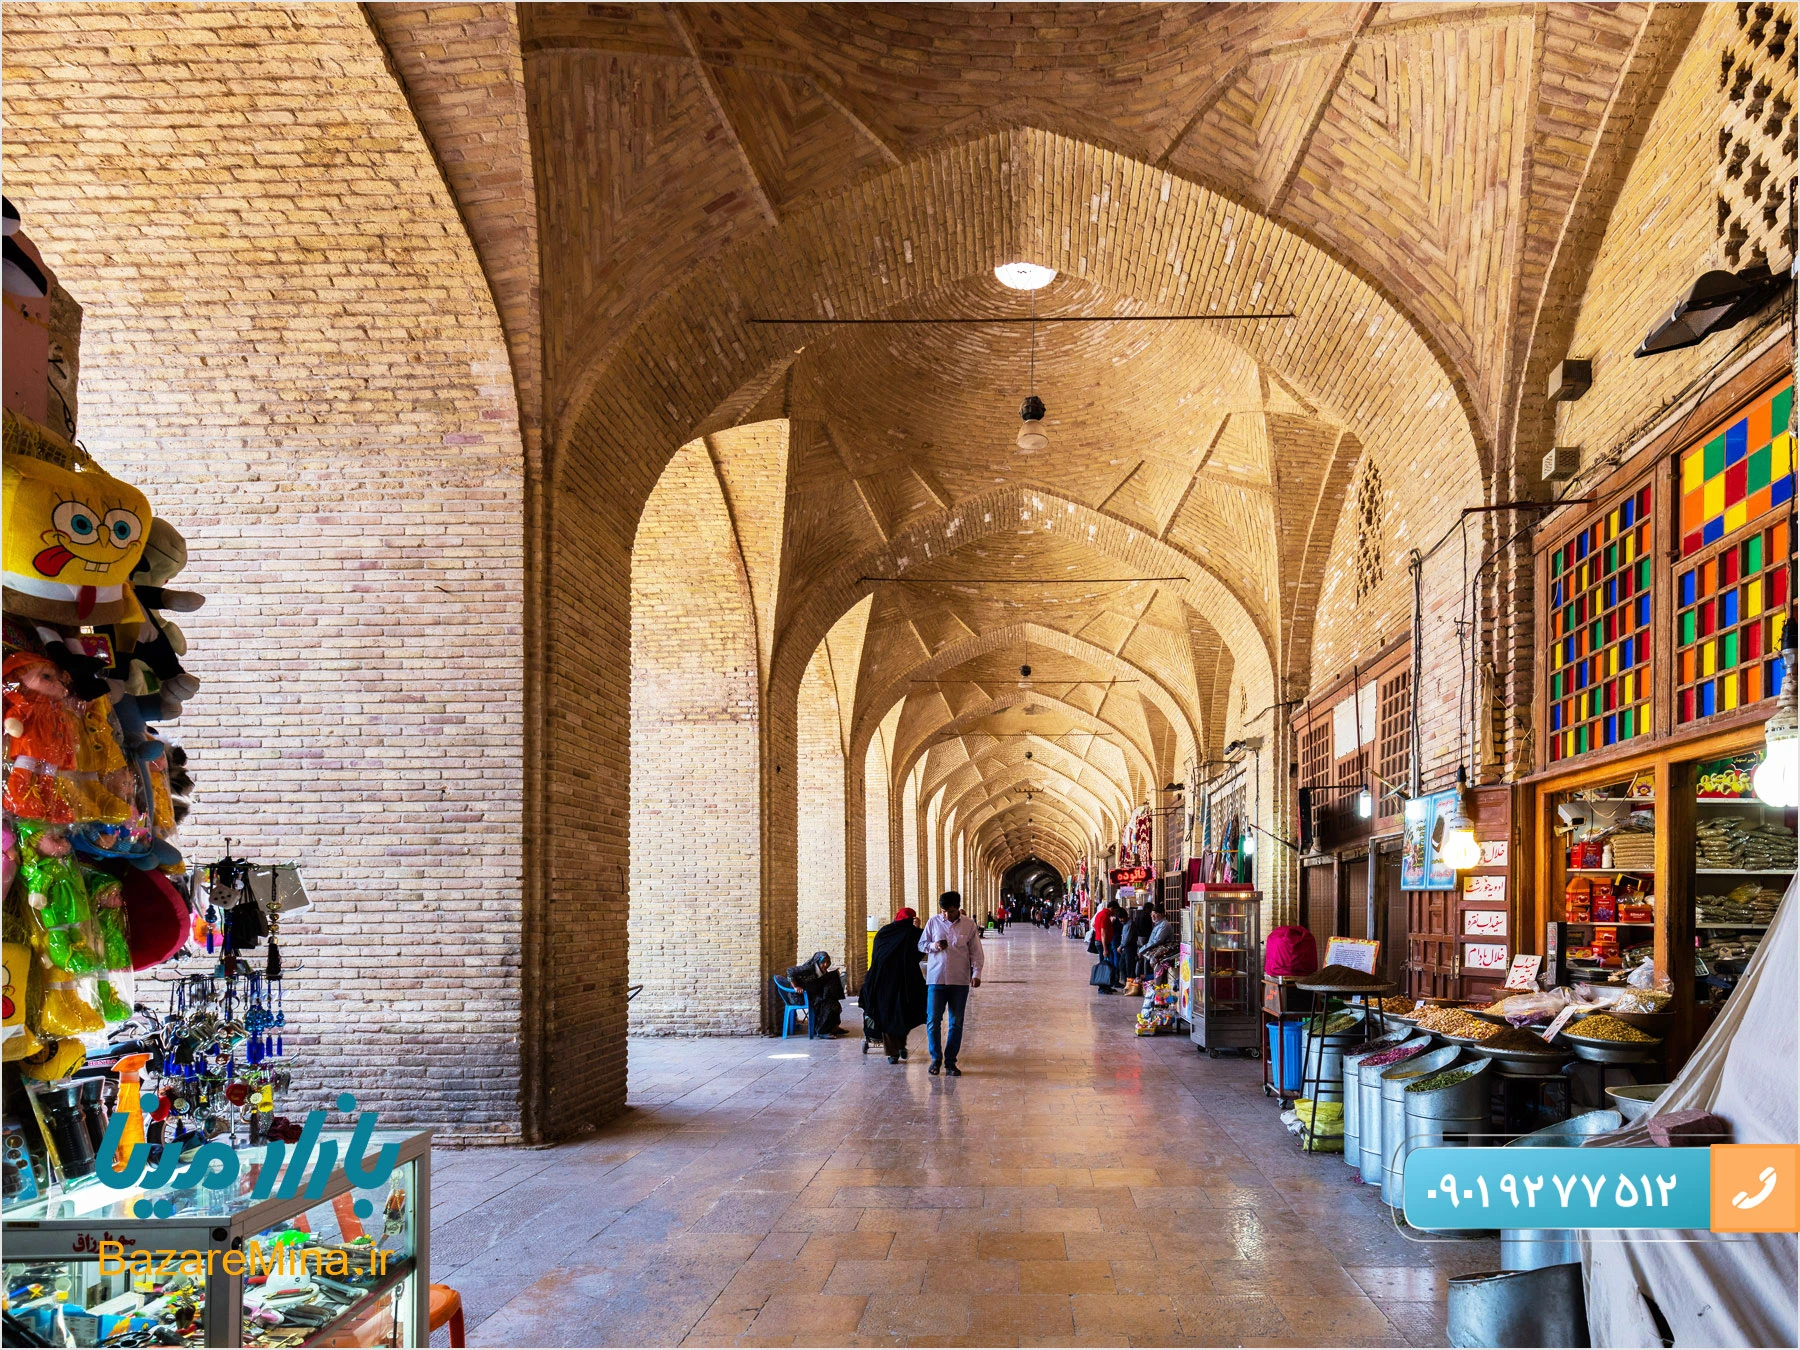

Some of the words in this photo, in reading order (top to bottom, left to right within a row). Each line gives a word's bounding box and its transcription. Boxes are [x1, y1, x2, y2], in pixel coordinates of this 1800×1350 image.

[1484, 844, 1504, 863] خلال
[1117, 867, 1147, 882] فالوده
[1465, 877, 1491, 893] خورشت
[1487, 881, 1504, 897] ادویه
[1467, 913, 1479, 930] نقره
[1476, 915, 1504, 933] سفیداب
[1468, 946, 1487, 966] بادام
[1483, 946, 1505, 967] خلال
[1513, 957, 1538, 973] سفیداب
